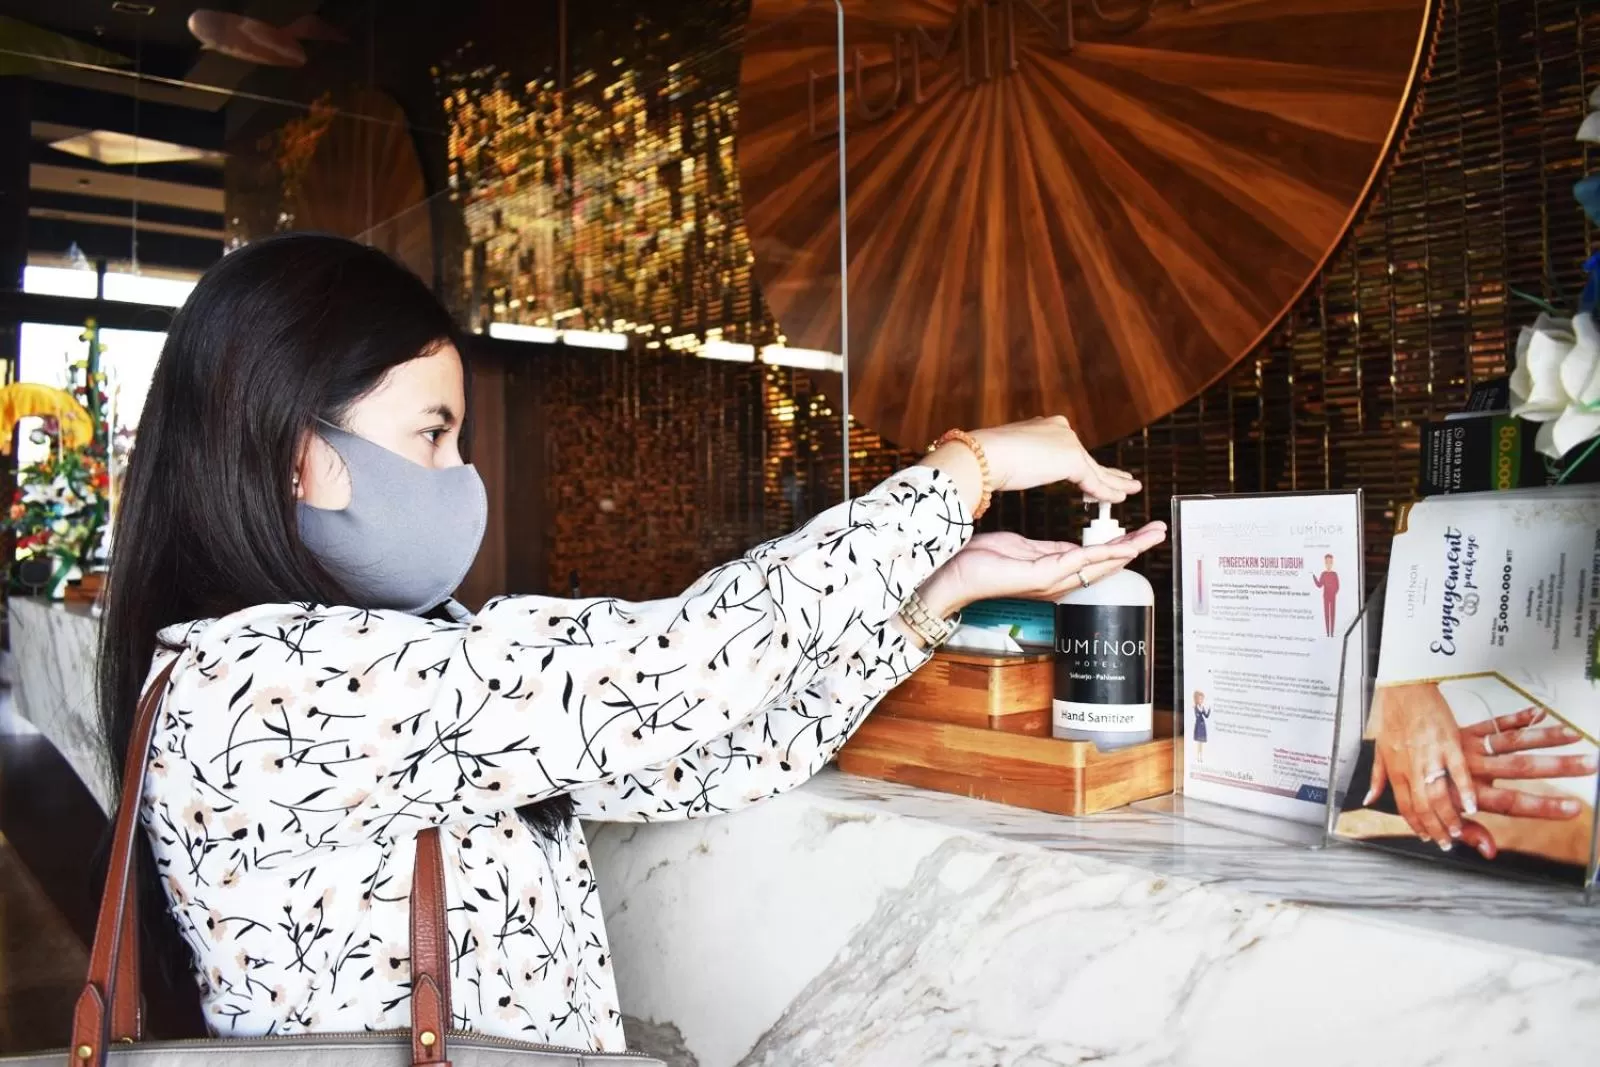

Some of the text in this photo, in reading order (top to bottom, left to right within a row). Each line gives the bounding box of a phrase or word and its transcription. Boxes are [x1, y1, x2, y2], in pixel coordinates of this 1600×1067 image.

[1218, 556, 1304, 569] PENGECEKAN SUHU TUBUH
[1463, 534, 1479, 589] package
[1430, 526, 1462, 656] Engagement
[1498, 565, 1512, 632] 5.000.000
[1075, 660, 1119, 668] HOTEL
[1061, 710, 1135, 724] Hand Sanitizer
